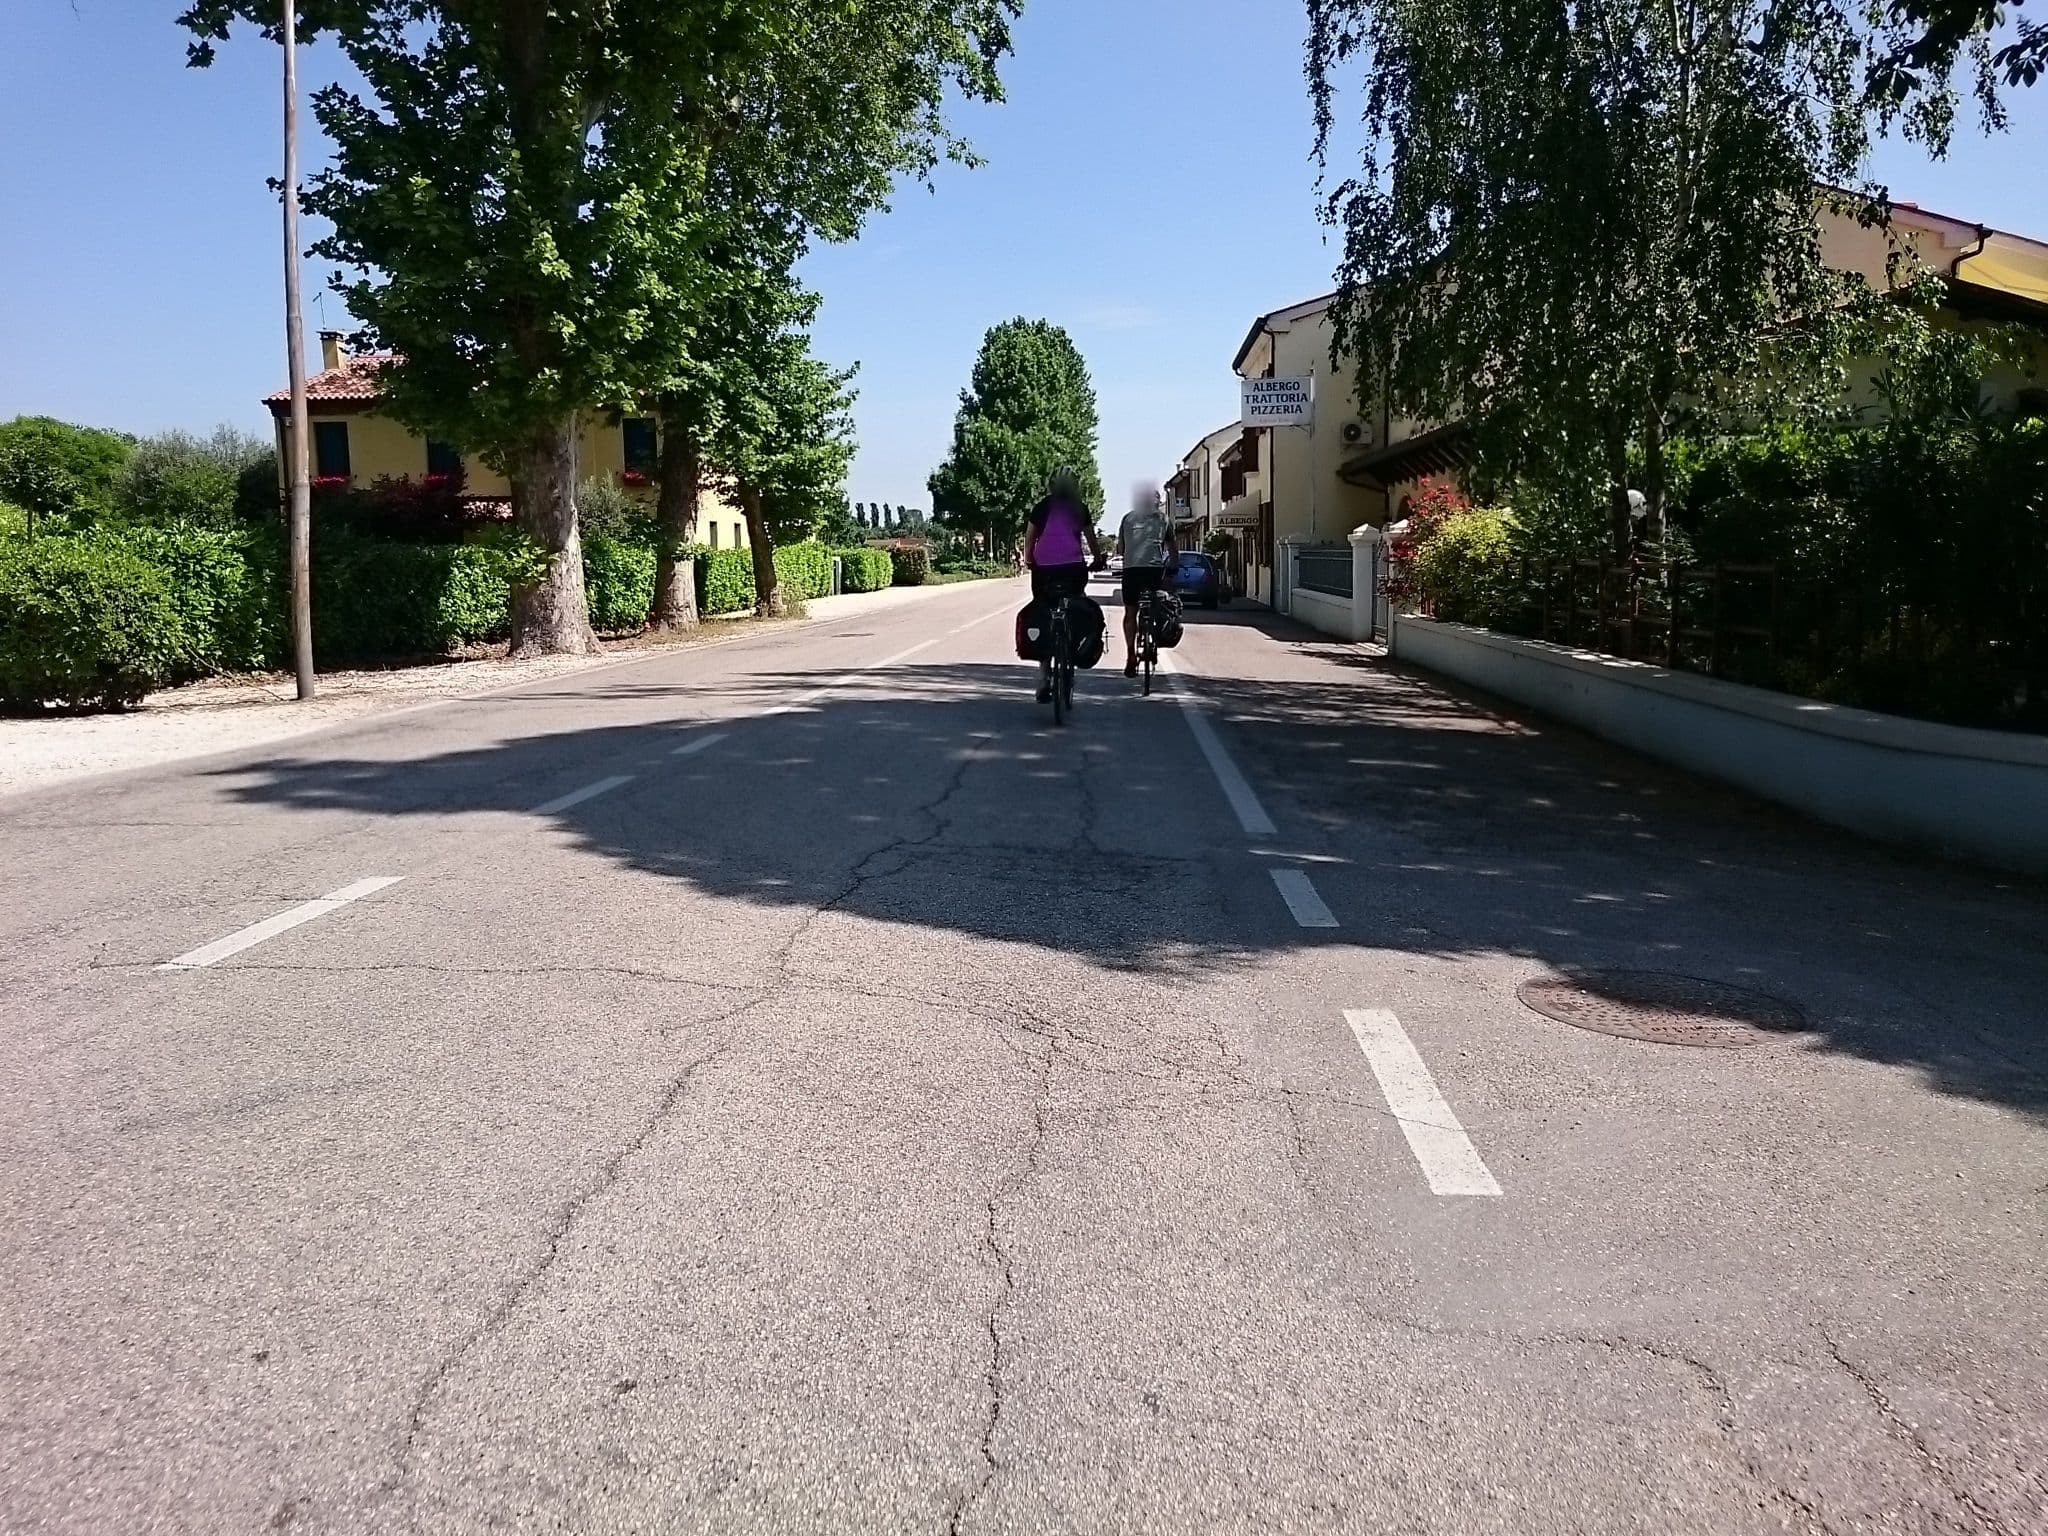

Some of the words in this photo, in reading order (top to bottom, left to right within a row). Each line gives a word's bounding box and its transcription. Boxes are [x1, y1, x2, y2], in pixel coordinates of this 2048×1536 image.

[1253, 381, 1300, 392] ALBERGO
[1243, 393, 1308, 404] TRATTORIA
[1250, 405, 1303, 415] PIZZERIA
[1219, 517, 1259, 525] ALBERGO
